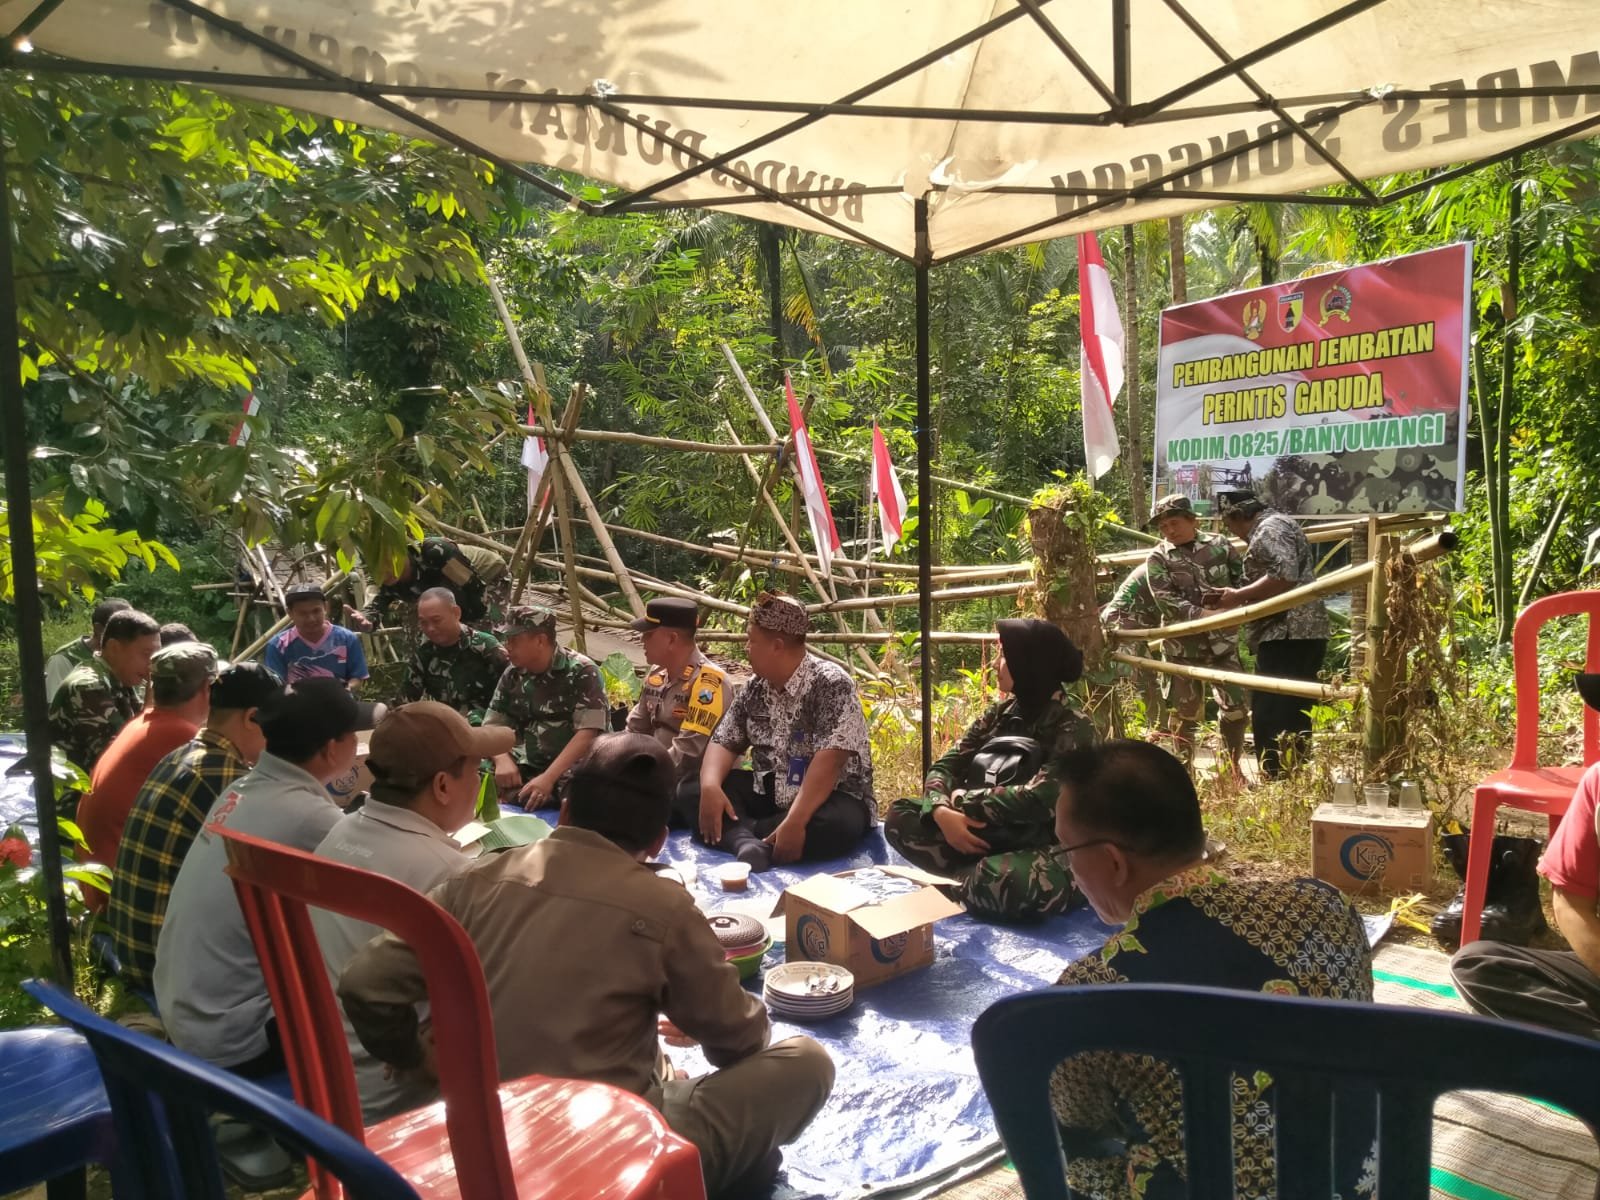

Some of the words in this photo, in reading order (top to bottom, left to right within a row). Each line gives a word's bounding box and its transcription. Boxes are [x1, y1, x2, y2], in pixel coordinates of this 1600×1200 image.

[1173, 342, 1315, 389] PEMBANGUNAN
[1317, 320, 1435, 368] JEMBATAN
[1202, 384, 1287, 425] PERINTIS
[1294, 371, 1385, 416] GARUDA
[1167, 435, 1225, 463] KODIM
[1228, 414, 1446, 459] 0825/BANYUWANGI
